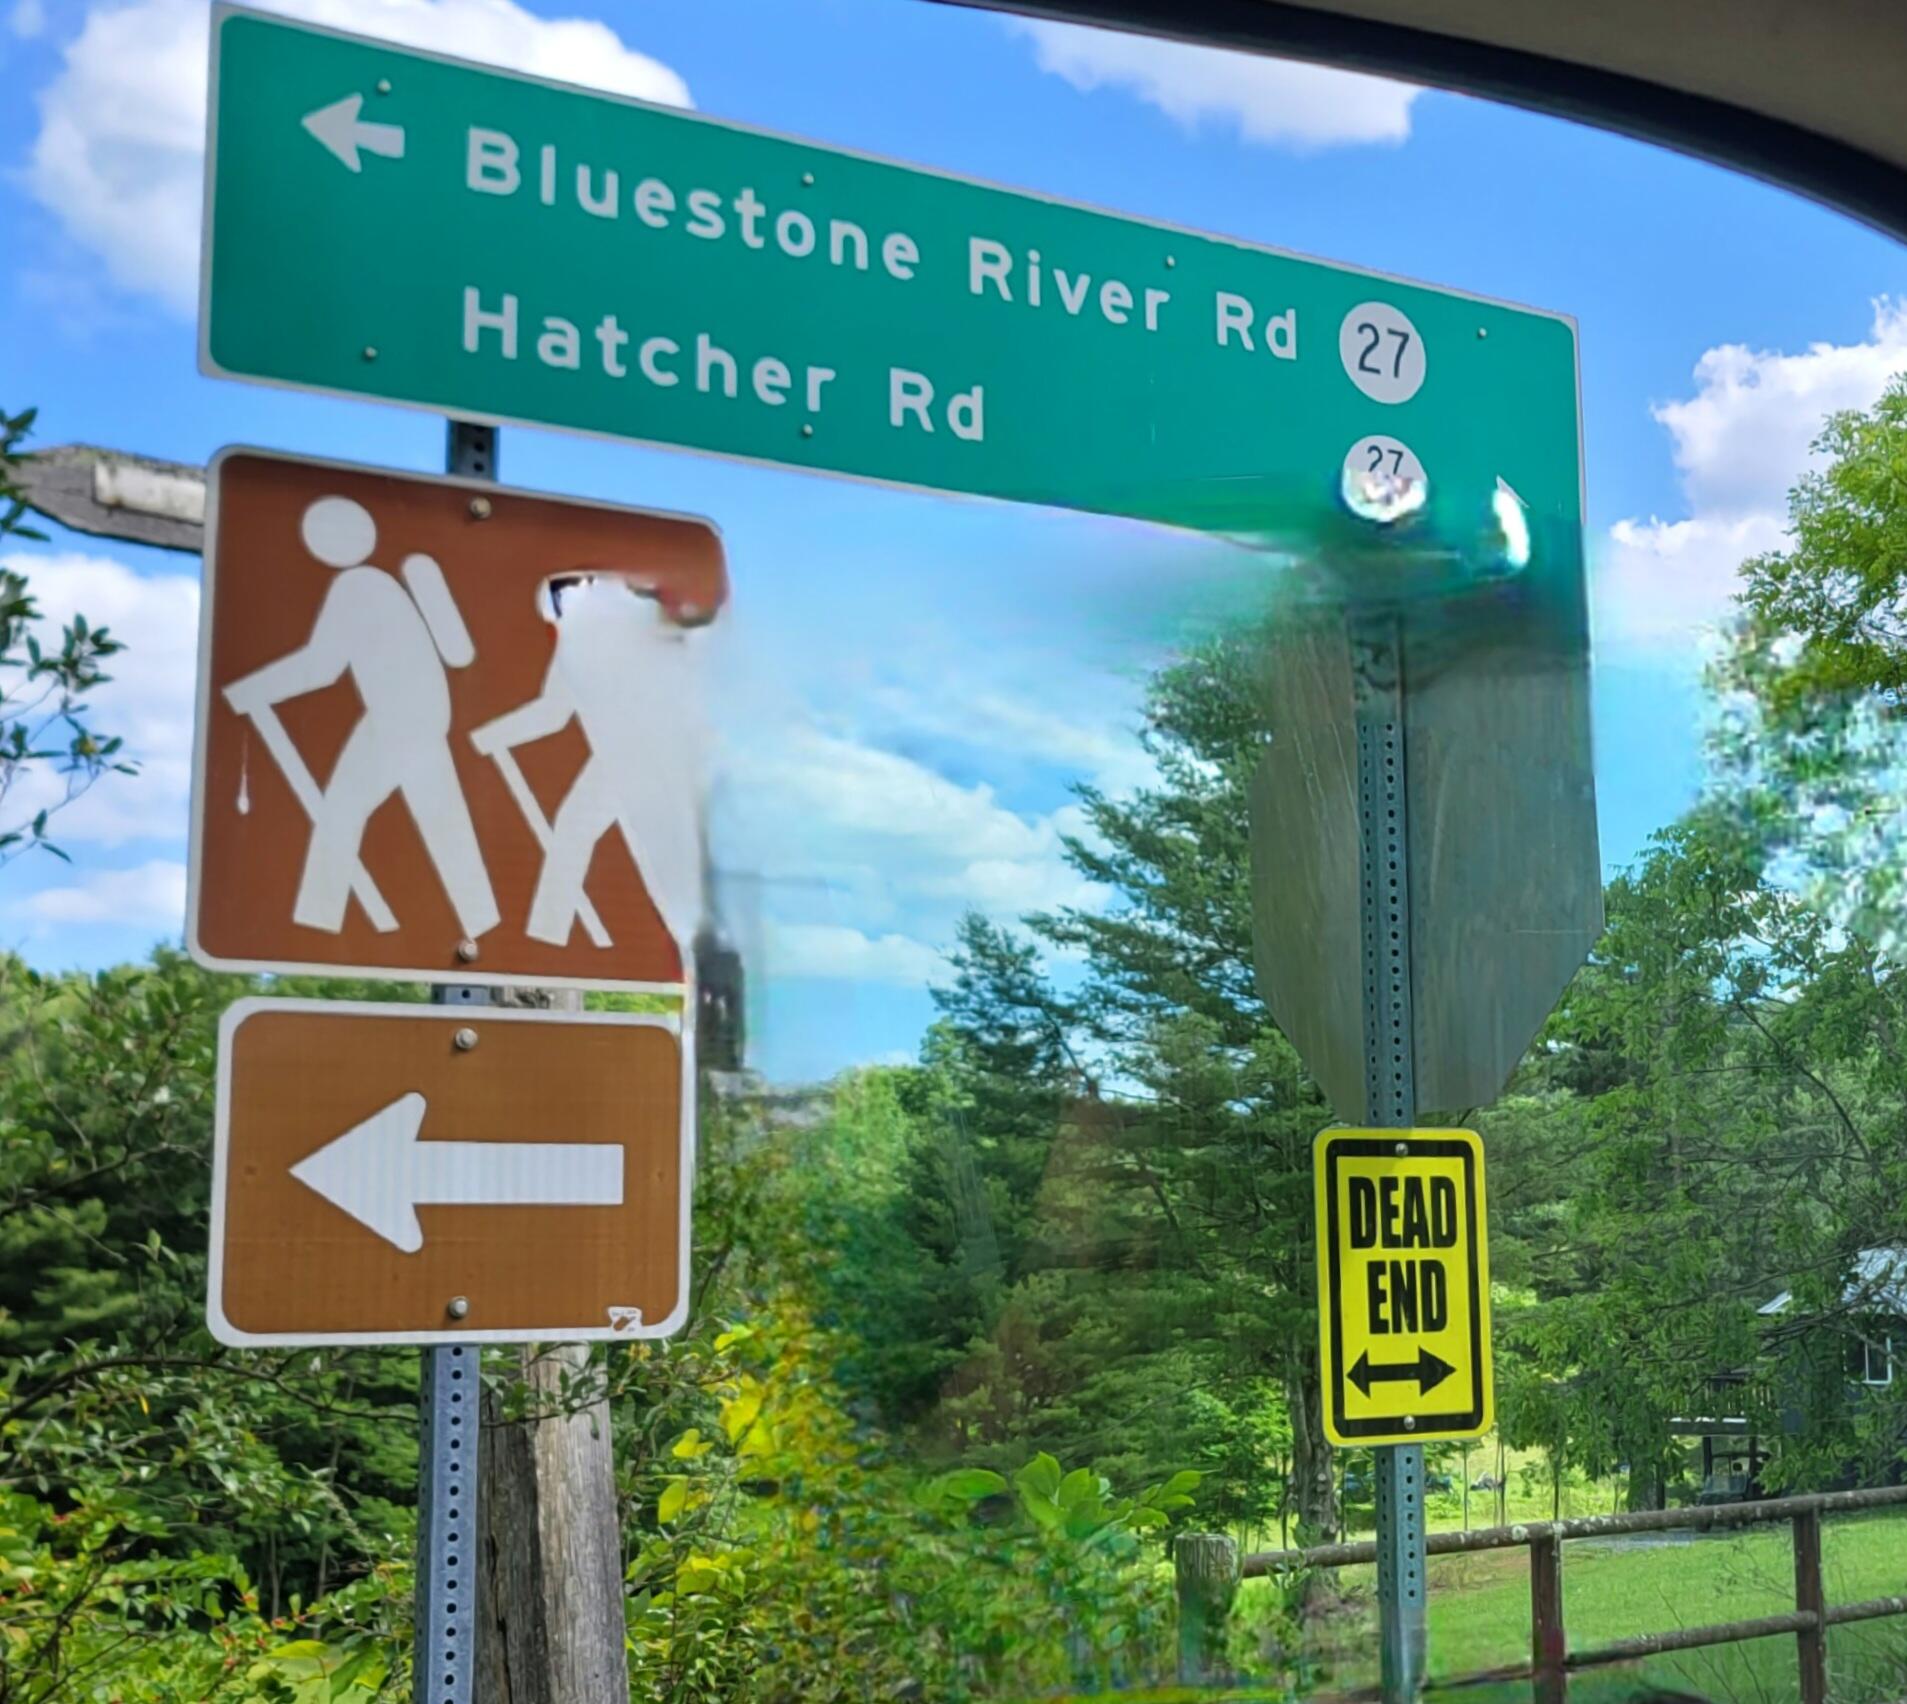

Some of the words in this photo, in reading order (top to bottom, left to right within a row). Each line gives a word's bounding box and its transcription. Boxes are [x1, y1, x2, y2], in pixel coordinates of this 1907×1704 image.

[465, 125, 920, 280] Bluestone
[969, 236, 1171, 331] River
[1216, 291, 1297, 360] Rd
[1356, 323, 1411, 379] 27
[463, 286, 836, 412] Hatcher
[889, 367, 984, 441] Rd
[1348, 1176, 1457, 1249] DEAD
[1367, 1259, 1447, 1335] END
